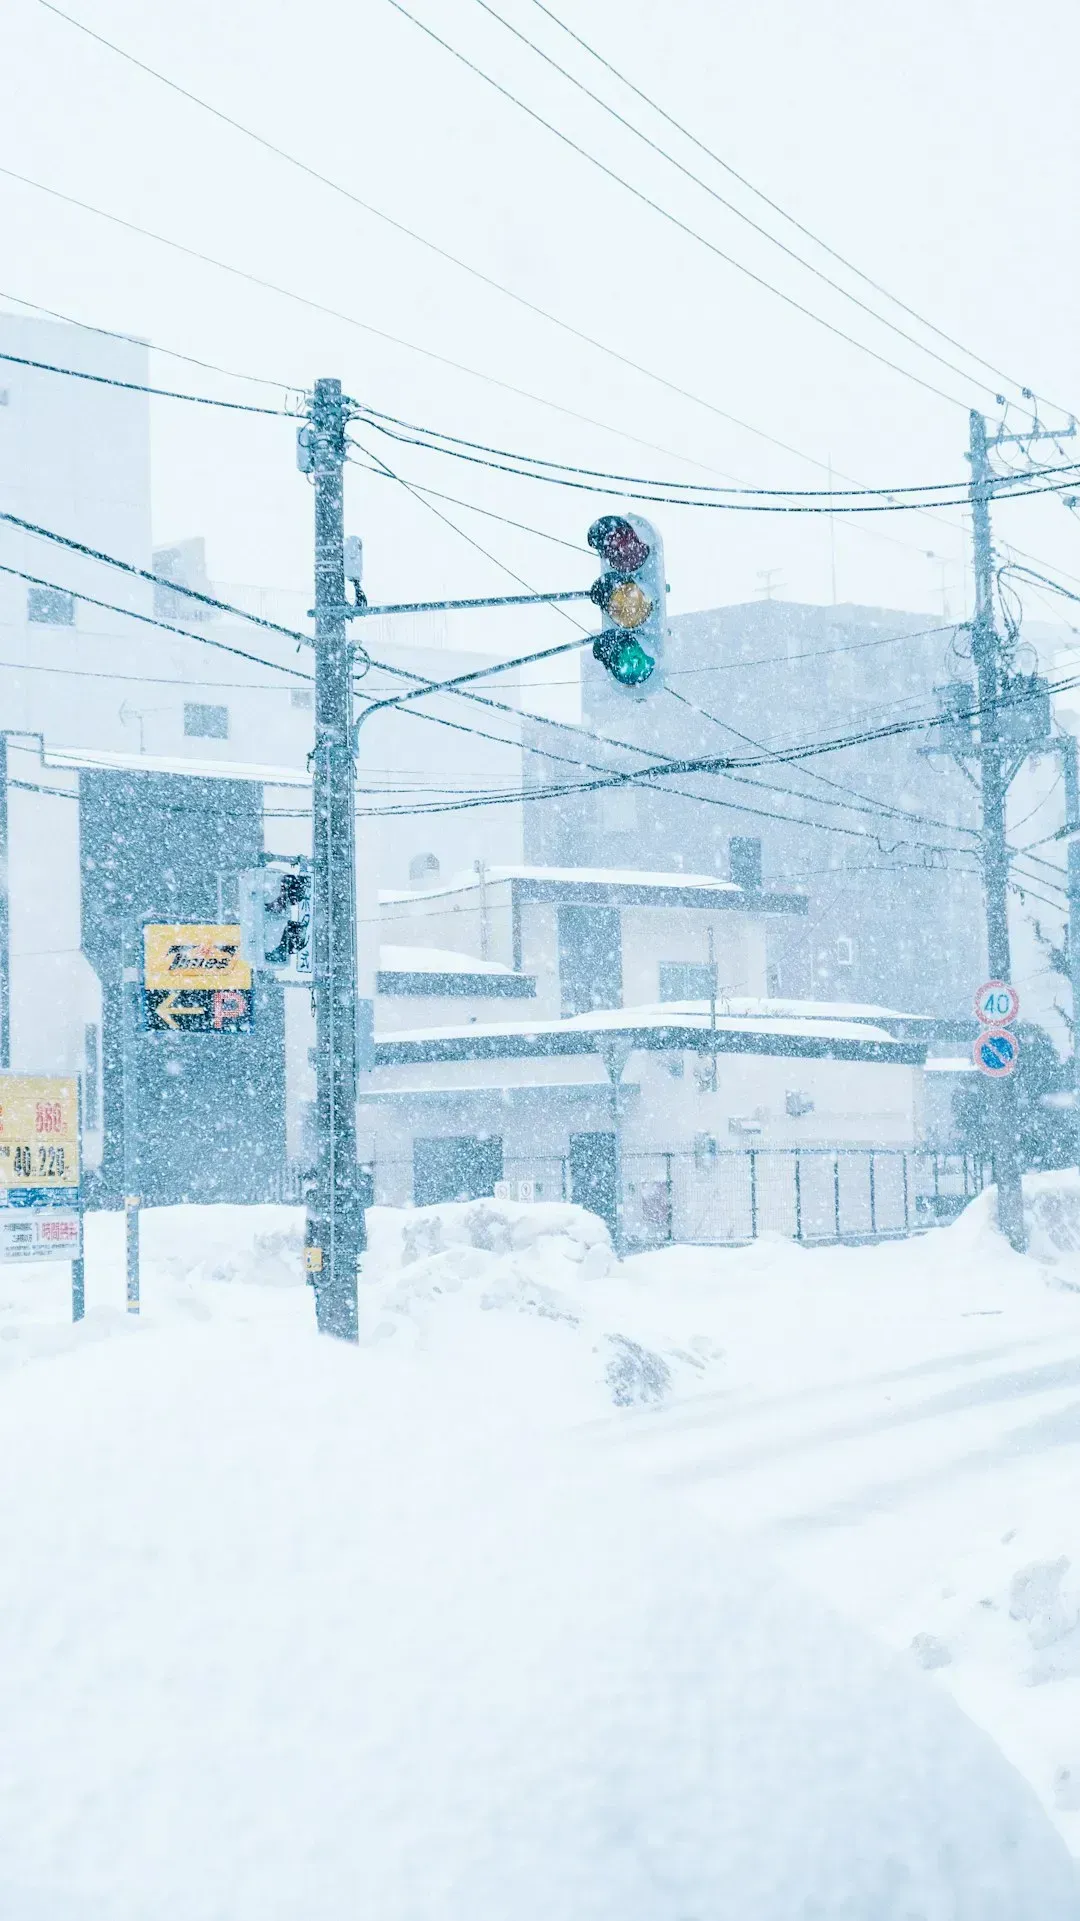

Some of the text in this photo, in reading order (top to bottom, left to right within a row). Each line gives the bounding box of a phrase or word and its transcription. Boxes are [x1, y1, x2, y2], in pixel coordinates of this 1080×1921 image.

[167, 945, 237, 970] Times
[213, 993, 246, 1028] P
[984, 994, 1009, 1013] 40
